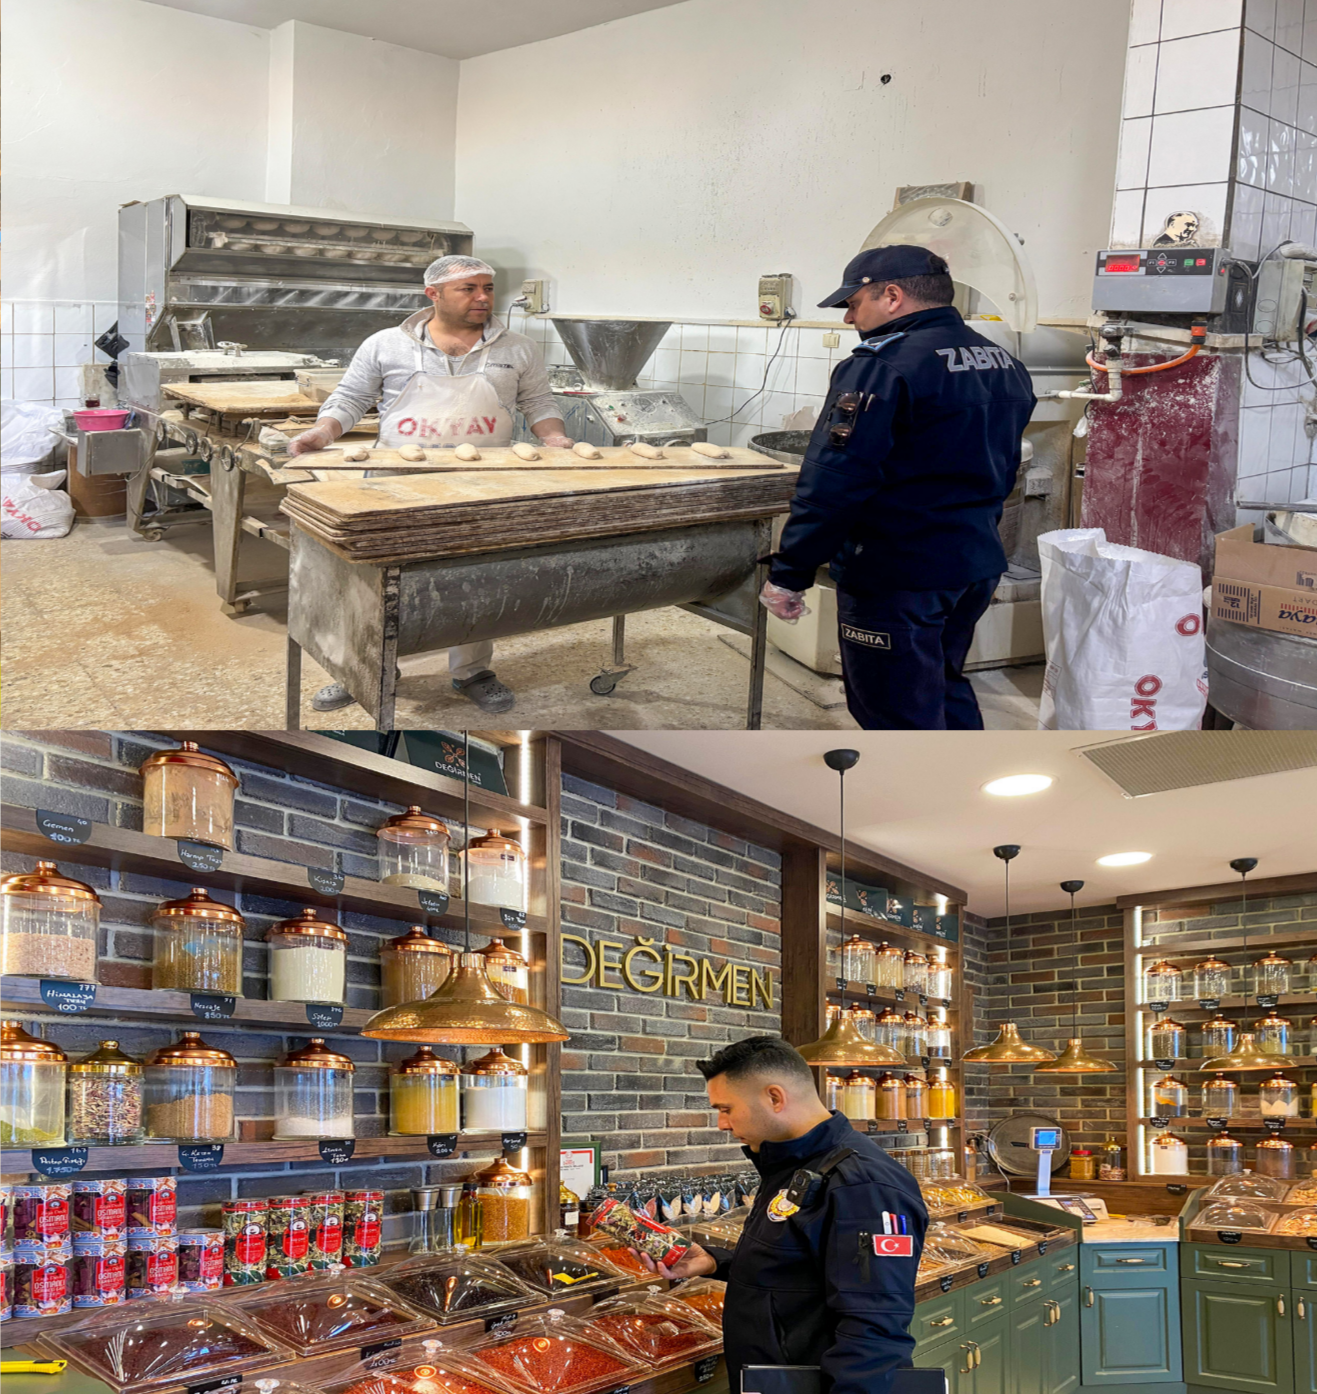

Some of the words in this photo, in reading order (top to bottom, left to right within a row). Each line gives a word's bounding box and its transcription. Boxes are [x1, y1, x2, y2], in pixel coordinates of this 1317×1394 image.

[935, 346, 1015, 372] ZABITA
[397, 416, 497, 438] OKYAY
[845, 628, 885, 646] ZABITA
[561, 934, 773, 1010] DEĞİRMEN
